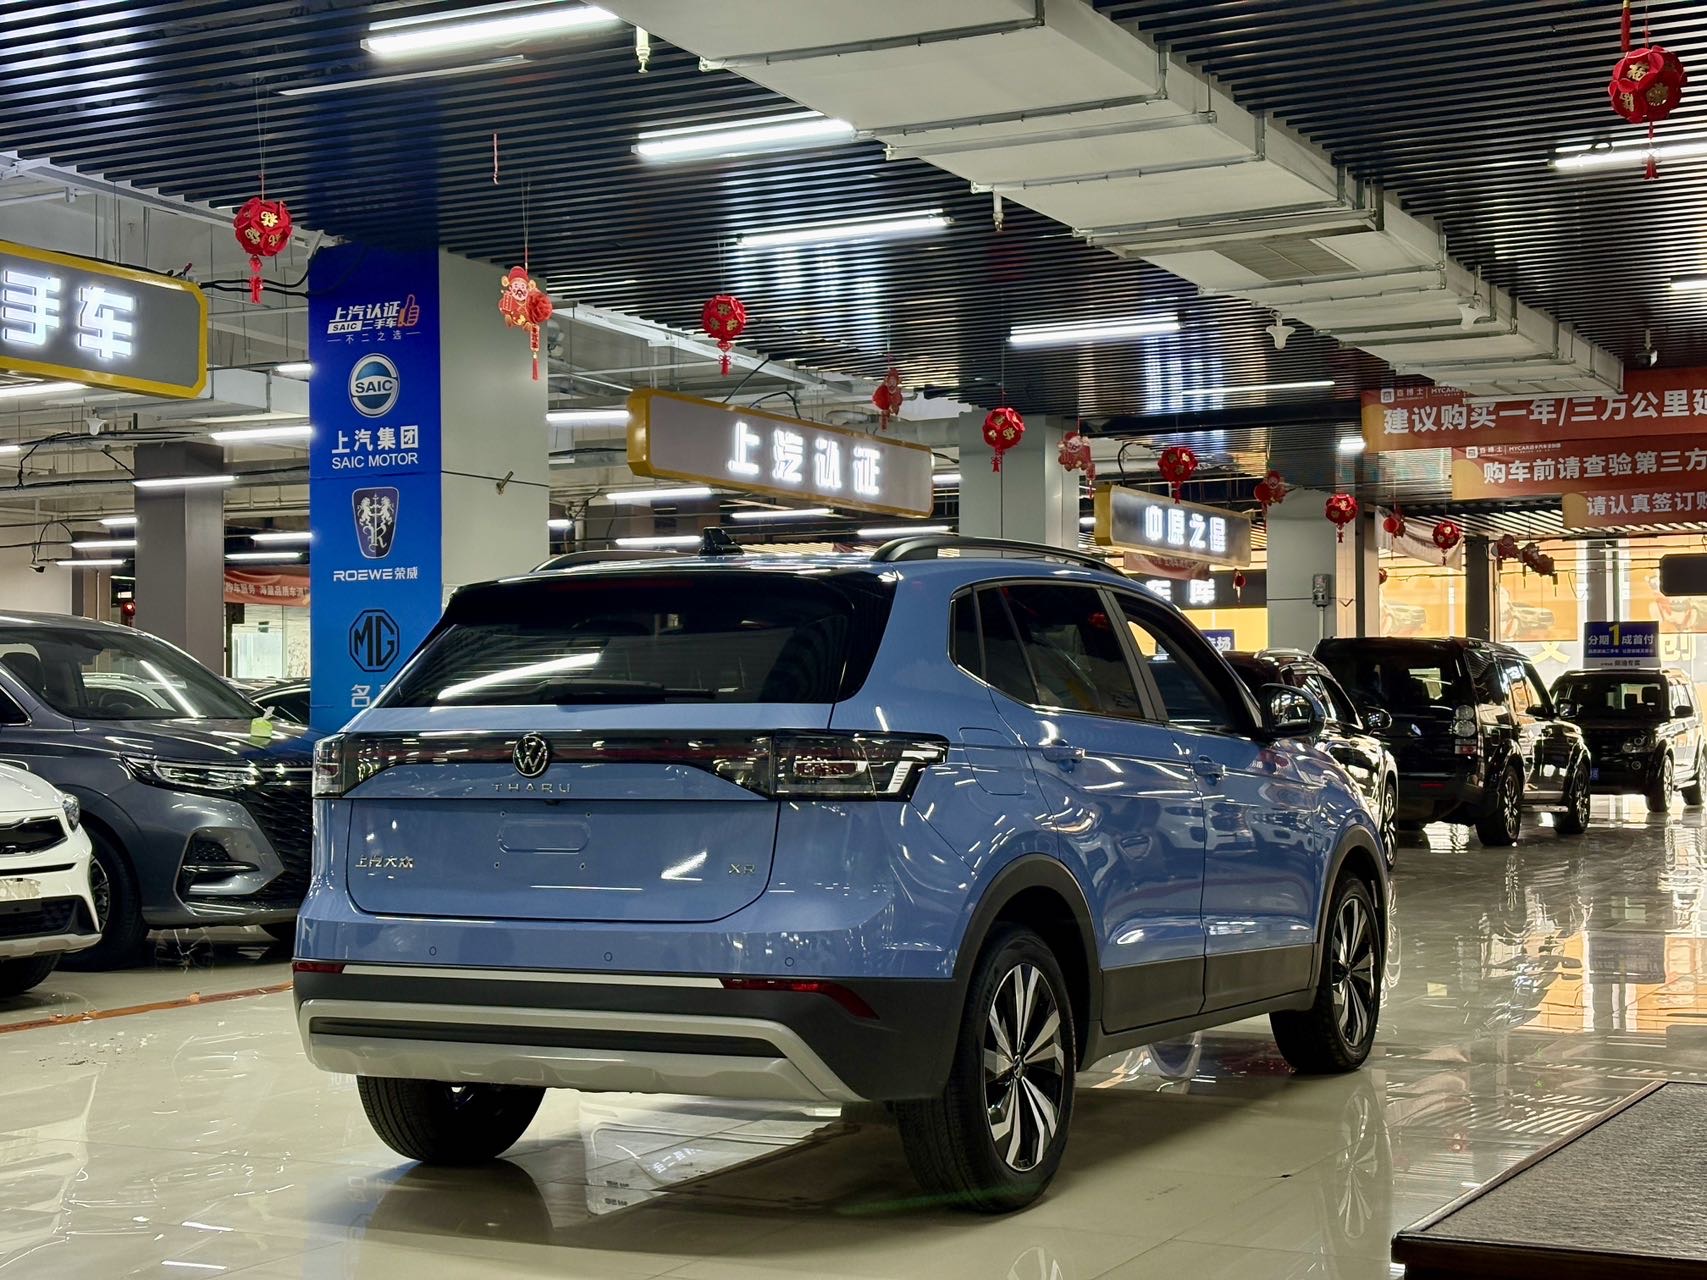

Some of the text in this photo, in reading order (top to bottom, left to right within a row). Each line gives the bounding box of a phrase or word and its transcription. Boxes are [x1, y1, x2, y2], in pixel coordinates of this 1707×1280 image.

[329, 301, 401, 323] 上汽认证
[332, 317, 398, 332] SAIC 二手车
[345, 329, 402, 345] 不二之选
[355, 380, 393, 394] SAIC
[331, 425, 419, 454] 上汽集团
[331, 452, 419, 470] SAIC MOTOR
[727, 420, 881, 496] 上汽认证
[1483, 447, 1707, 484] 购车前请查验第三方
[333, 567, 418, 582] ROEWE 荣威
[354, 615, 395, 667] MG
[1588, 624, 1655, 646] 分期1成首付
[491, 783, 572, 793] THARU
[355, 855, 414, 868] 上汽大众
